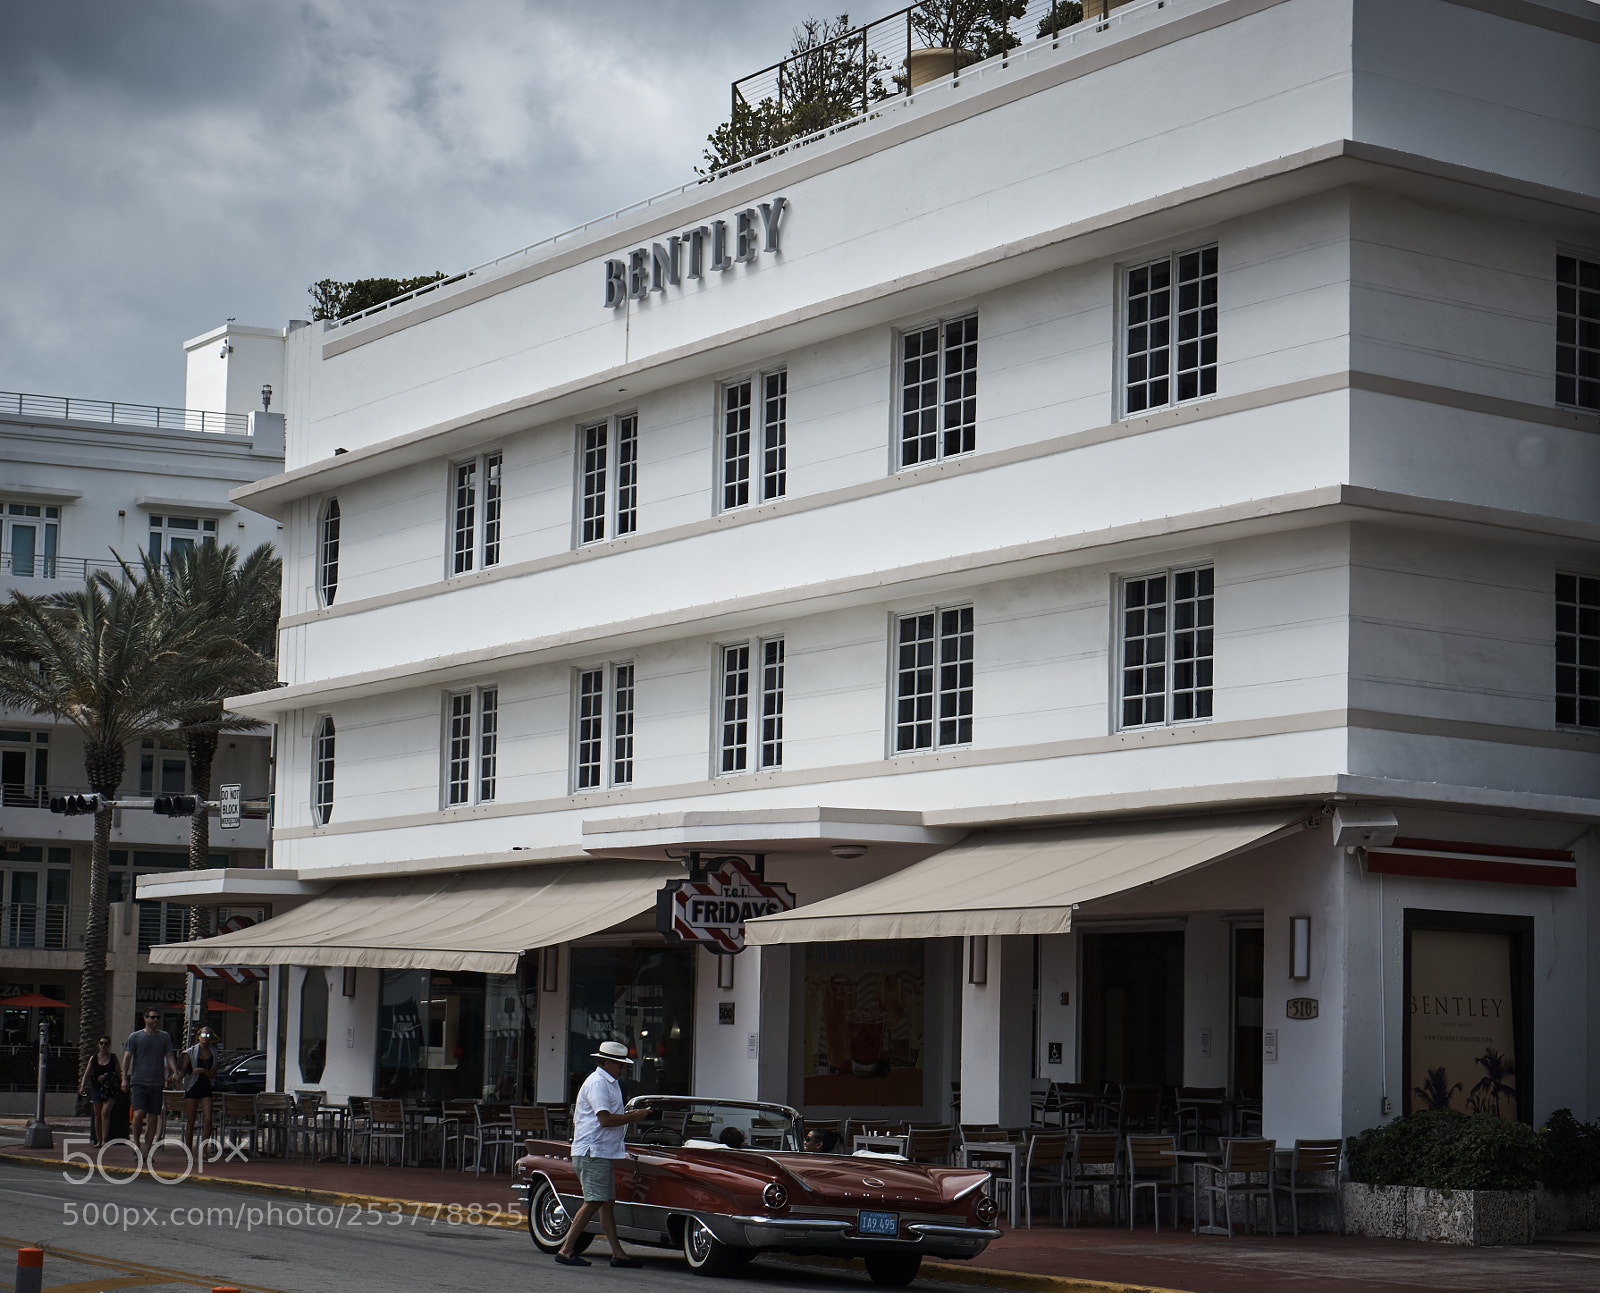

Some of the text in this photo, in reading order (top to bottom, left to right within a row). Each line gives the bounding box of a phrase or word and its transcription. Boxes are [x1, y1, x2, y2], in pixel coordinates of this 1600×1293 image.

[604, 197, 787, 308] BENTLEY
[221, 789, 240, 800] DO NOT
[222, 804, 239, 815] BLOCK
[723, 887, 748, 898] T.G.I.
[815, 943, 858, 964] ALWAYS
[137, 988, 185, 1001] WINGS
[719, 1006, 733, 1020] 500
[1292, 1000, 1312, 1017] 510
[879, 1218, 895, 1230] 495
